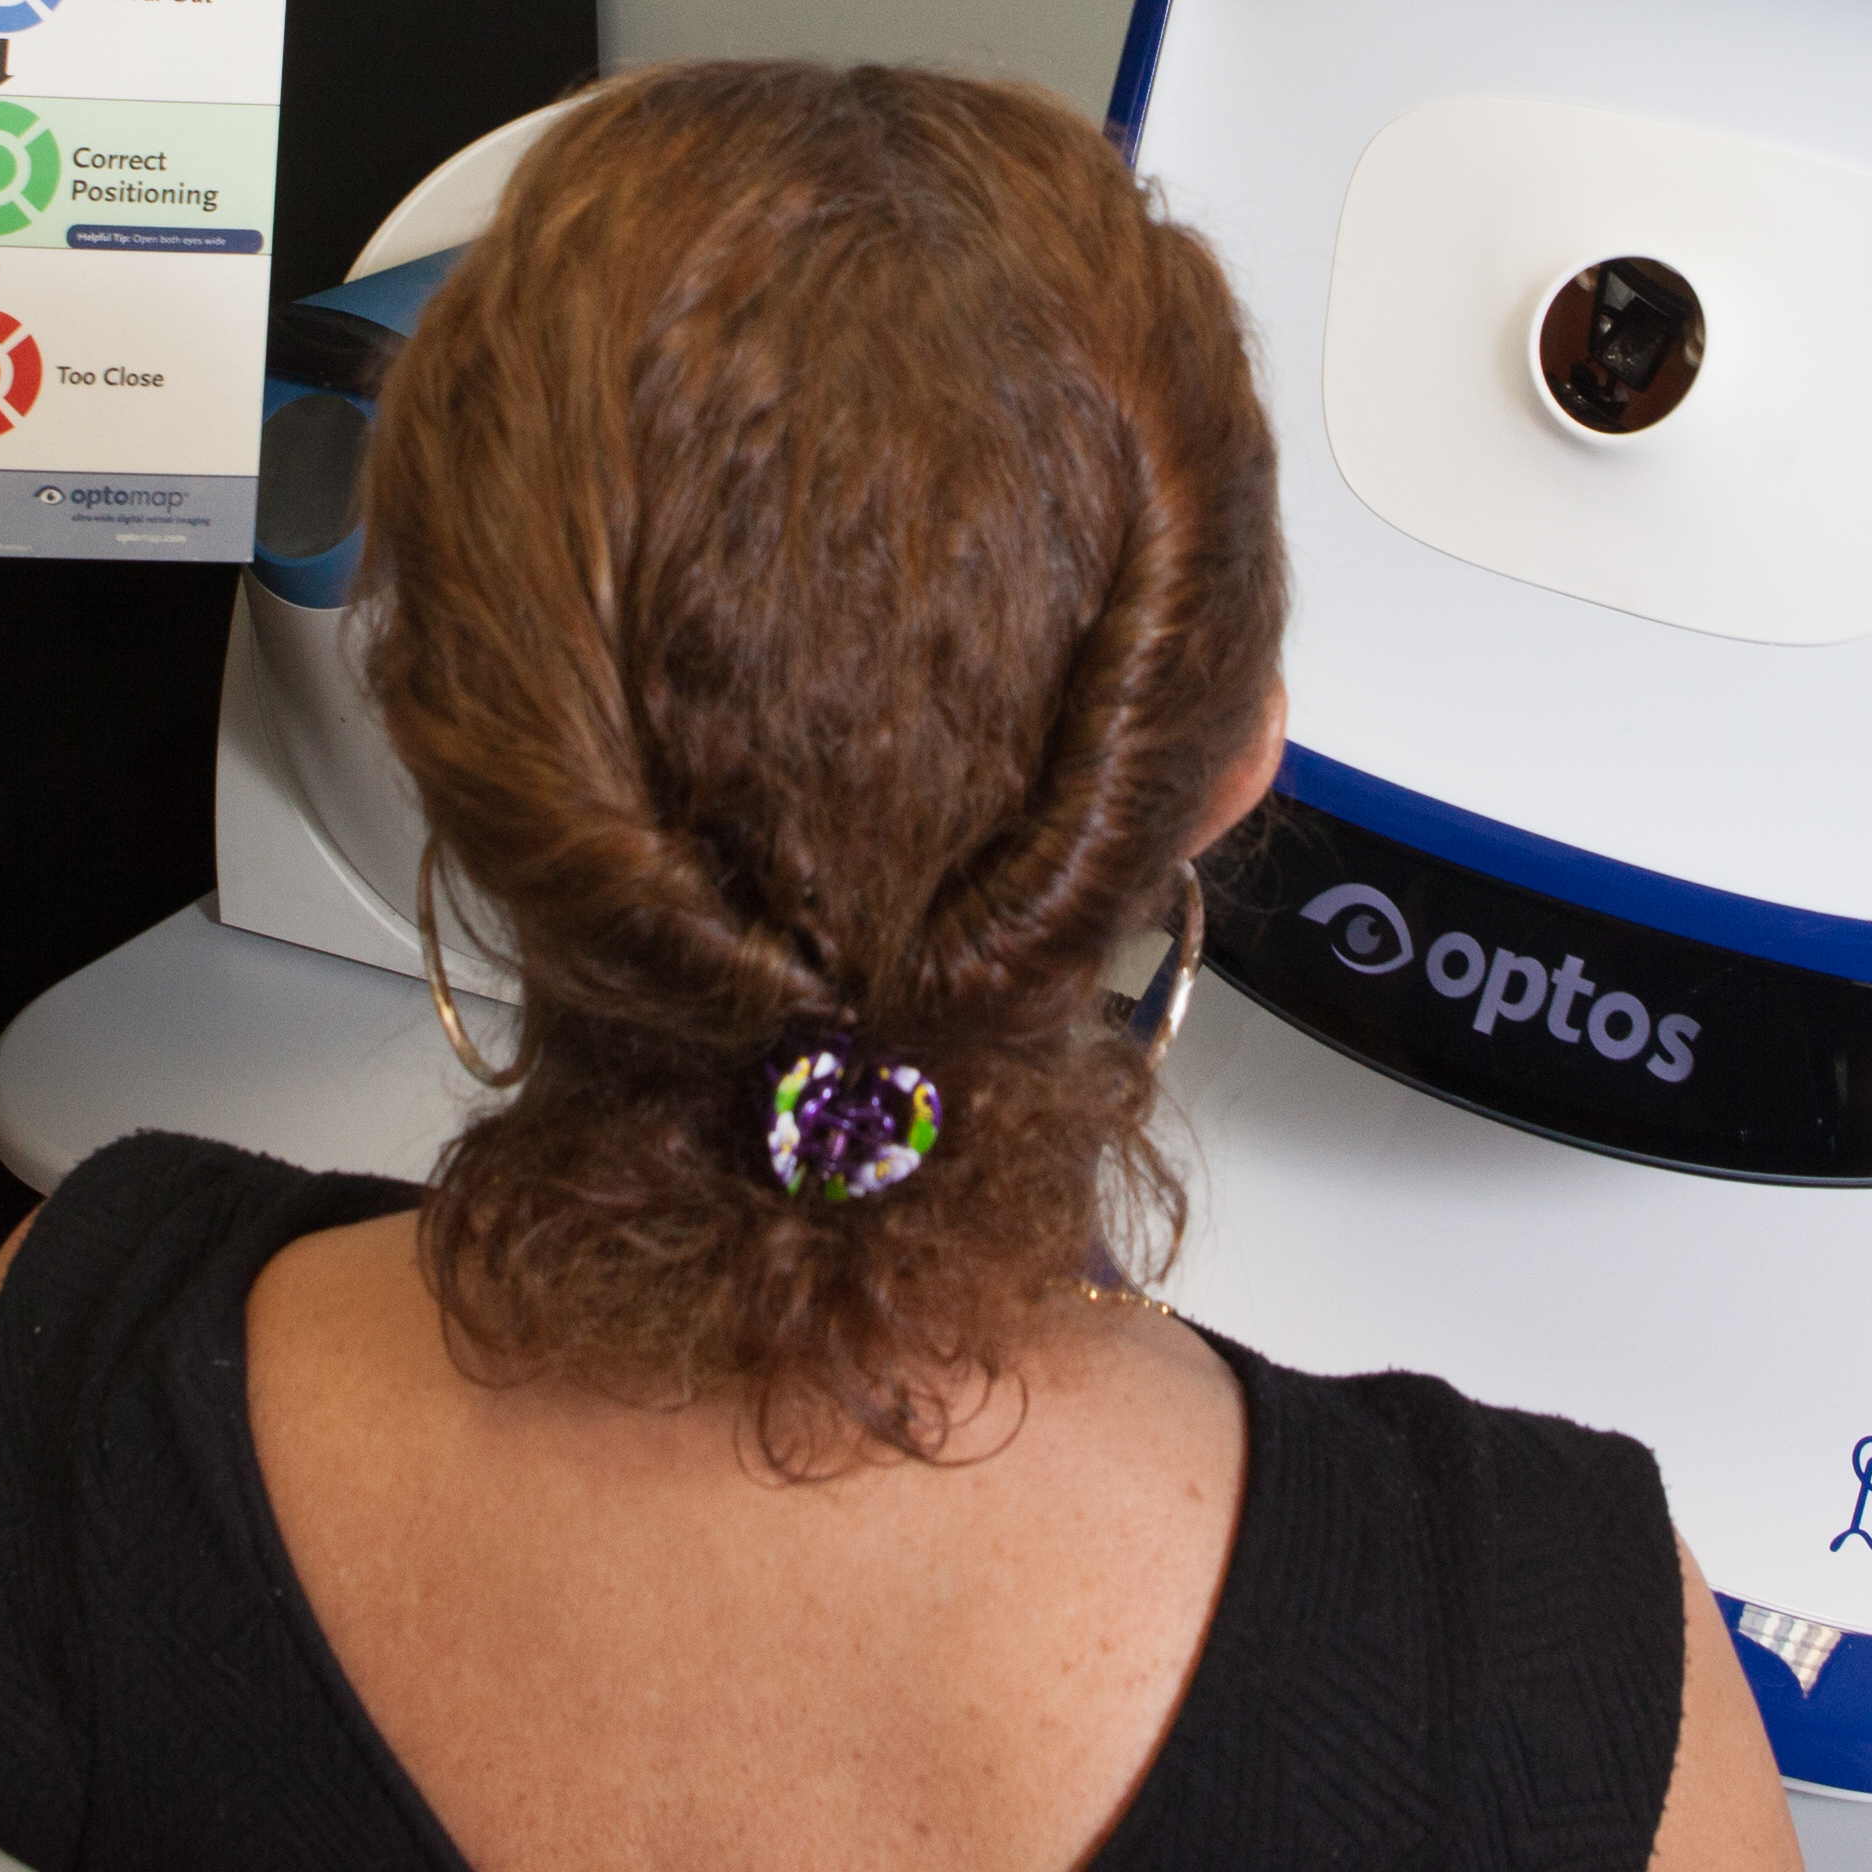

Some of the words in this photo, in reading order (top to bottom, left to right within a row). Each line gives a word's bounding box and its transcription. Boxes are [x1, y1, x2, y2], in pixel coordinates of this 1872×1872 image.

[73, 146, 167, 171] Correct
[72, 179, 219, 212] Positioning
[76, 232, 112, 243] Helpful
[133, 234, 159, 244] Open
[160, 235, 181, 244] both
[182, 238, 203, 246] eyes
[205, 237, 226, 246] wide
[58, 366, 96, 387] Too
[103, 366, 165, 389] Close
[1426, 932, 1703, 1084] optos
